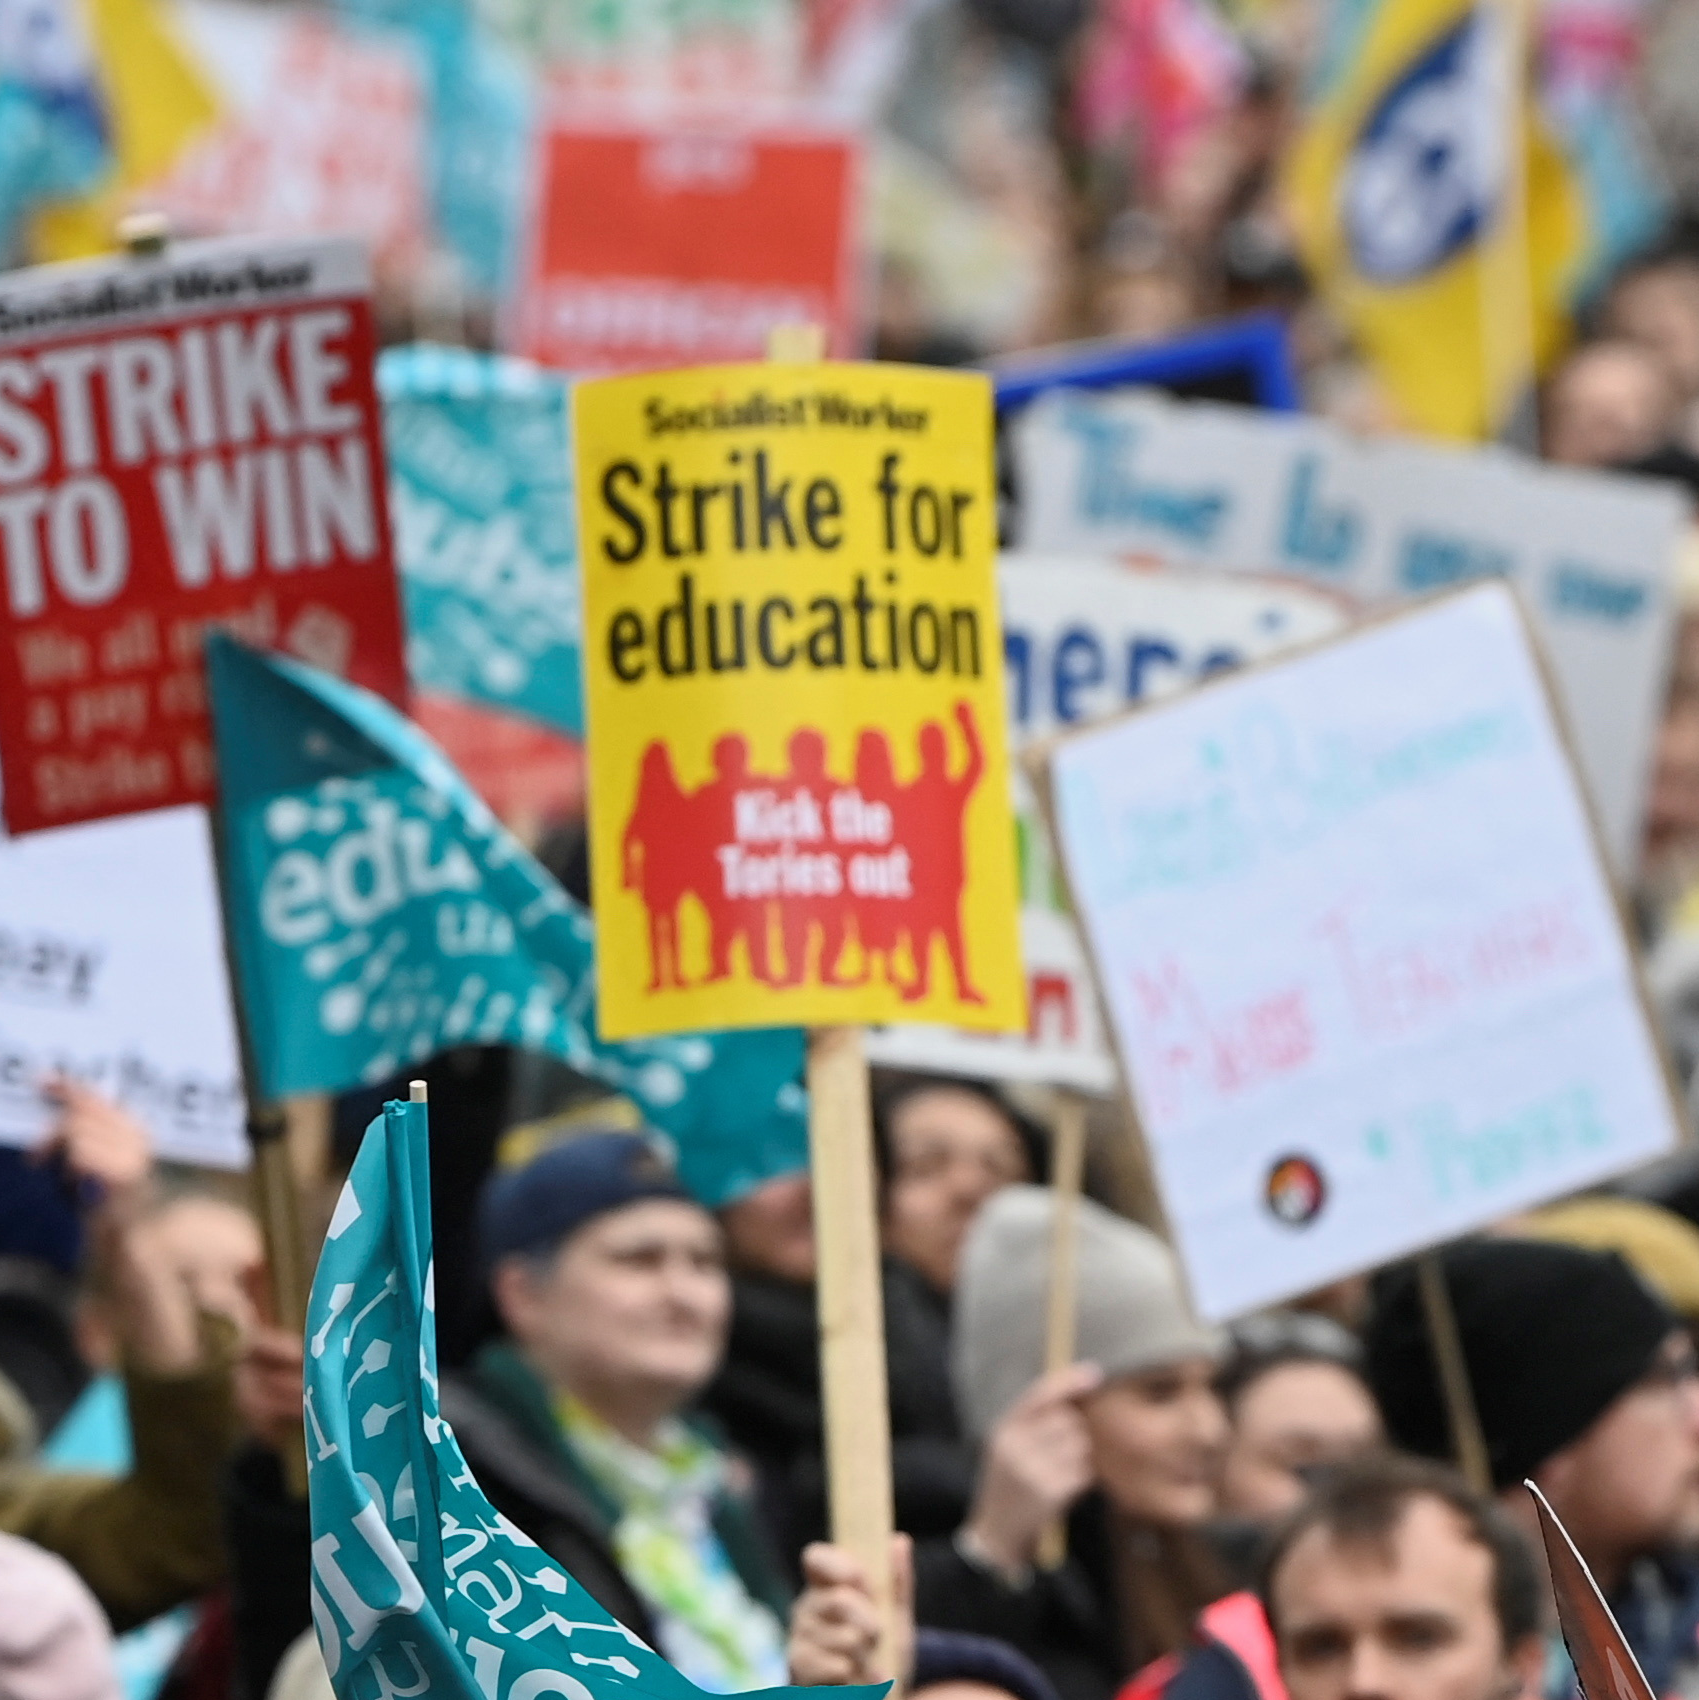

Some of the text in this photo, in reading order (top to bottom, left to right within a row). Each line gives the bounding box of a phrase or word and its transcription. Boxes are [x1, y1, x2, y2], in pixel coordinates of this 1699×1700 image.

[168, 258, 316, 306] Worker
[644, 394, 932, 438] Socialist Worker
[154, 435, 376, 588] WIN
[601, 450, 844, 566] Strike
[876, 452, 974, 560] for
[607, 572, 984, 684] education
[730, 788, 894, 844] Kick the
[716, 844, 913, 898] Tories out
